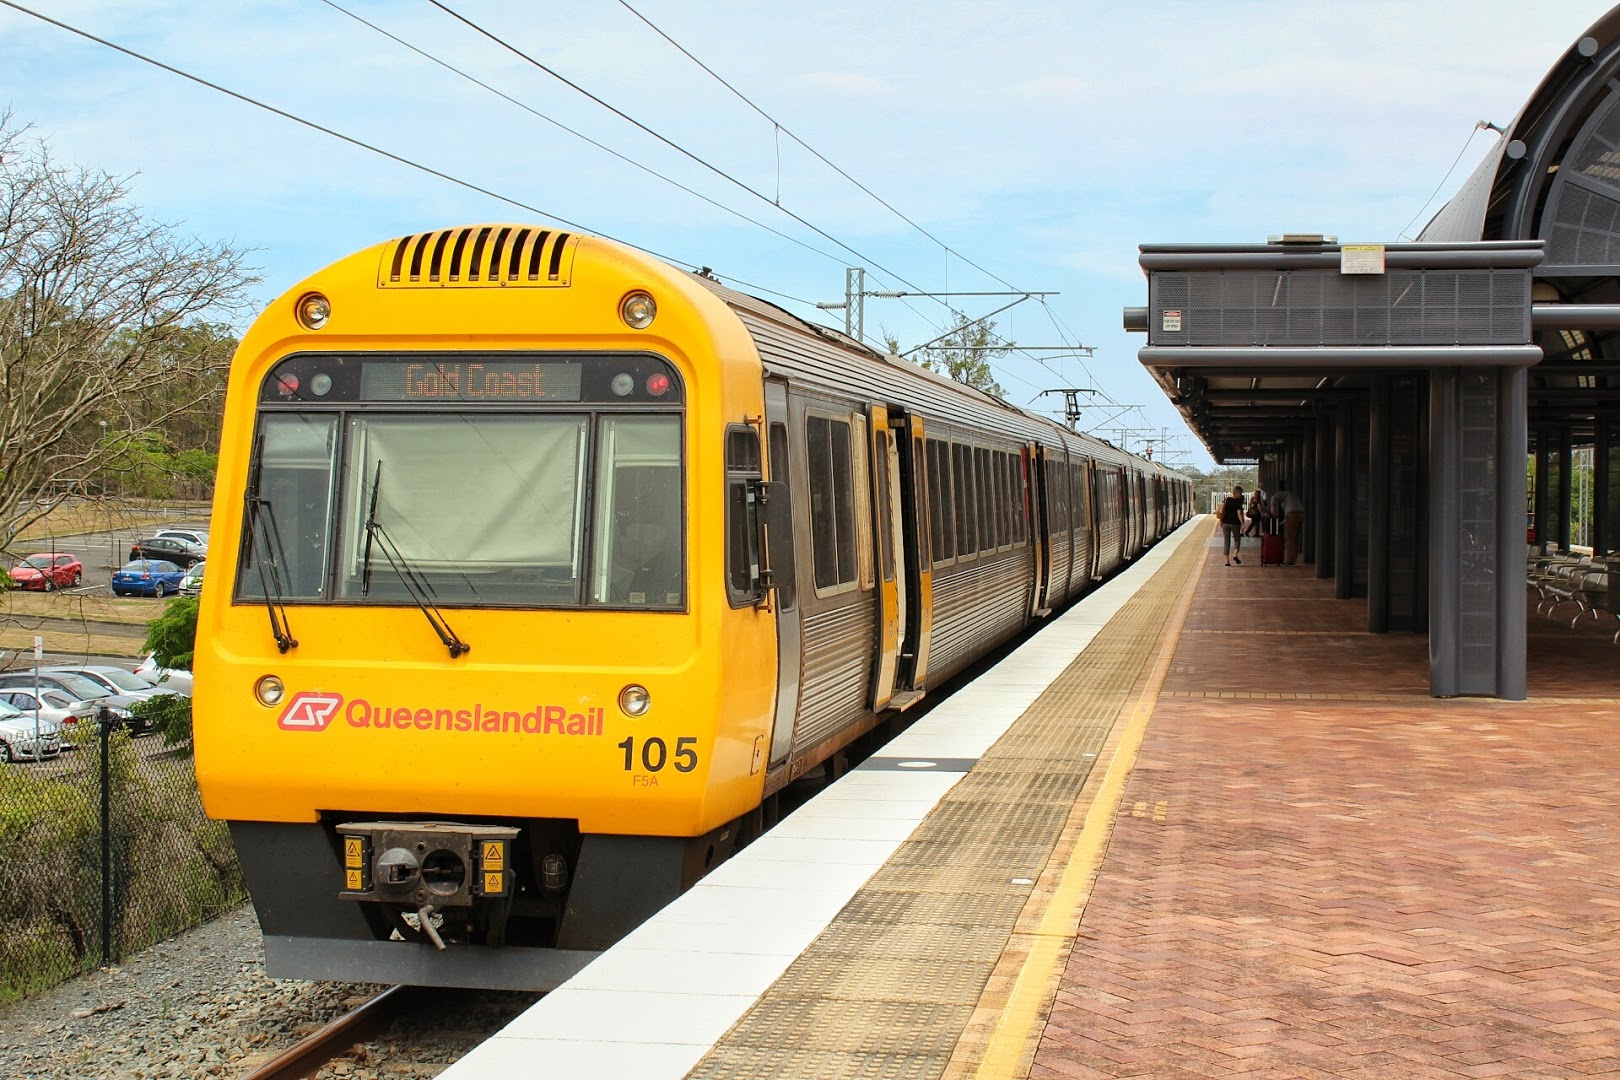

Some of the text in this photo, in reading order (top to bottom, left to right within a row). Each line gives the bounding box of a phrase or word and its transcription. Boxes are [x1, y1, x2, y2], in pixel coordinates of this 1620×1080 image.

[407, 364, 546, 396] Gold Coast
[345, 698, 604, 736] QueenslandRail
[618, 736, 698, 773] 105
[633, 775, 659, 787] F5A
